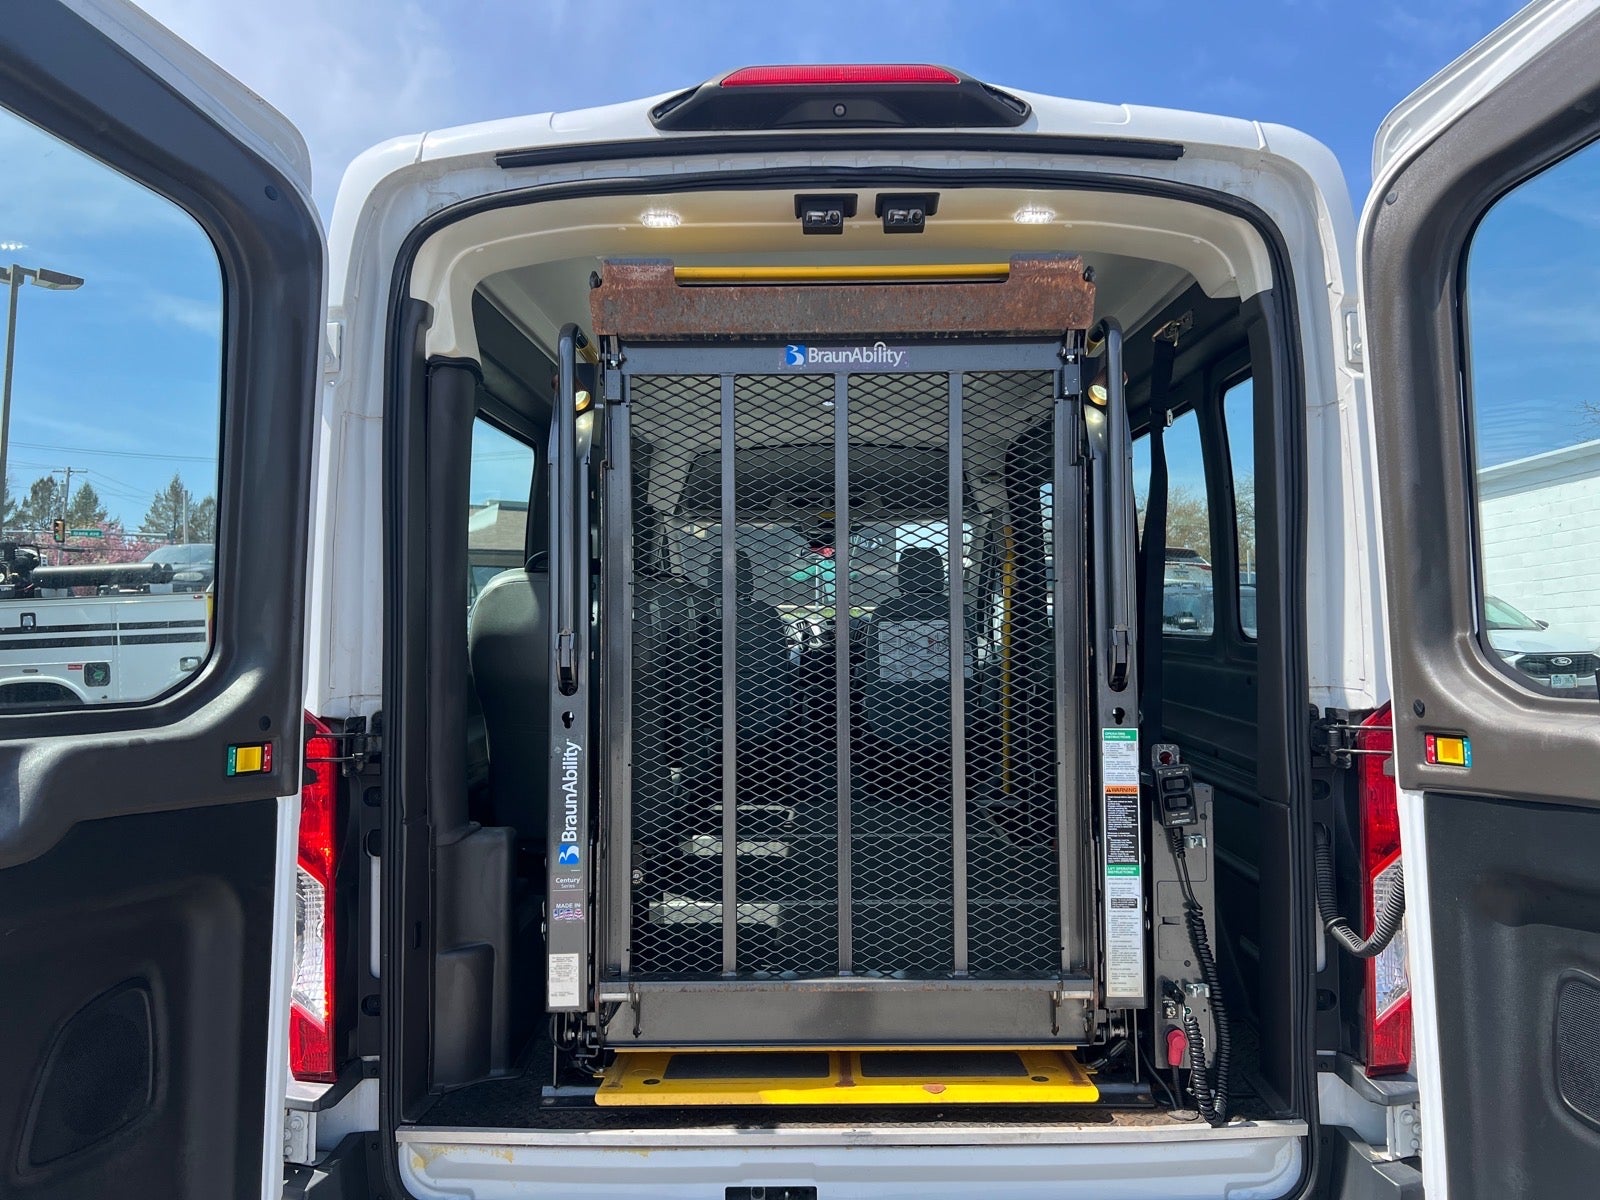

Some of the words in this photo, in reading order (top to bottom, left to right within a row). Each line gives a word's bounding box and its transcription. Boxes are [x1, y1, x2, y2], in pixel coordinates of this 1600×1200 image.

[808, 341, 903, 367] BraunAbility
[562, 740, 582, 842] BraunAbility
[553, 908, 584, 920] USA
